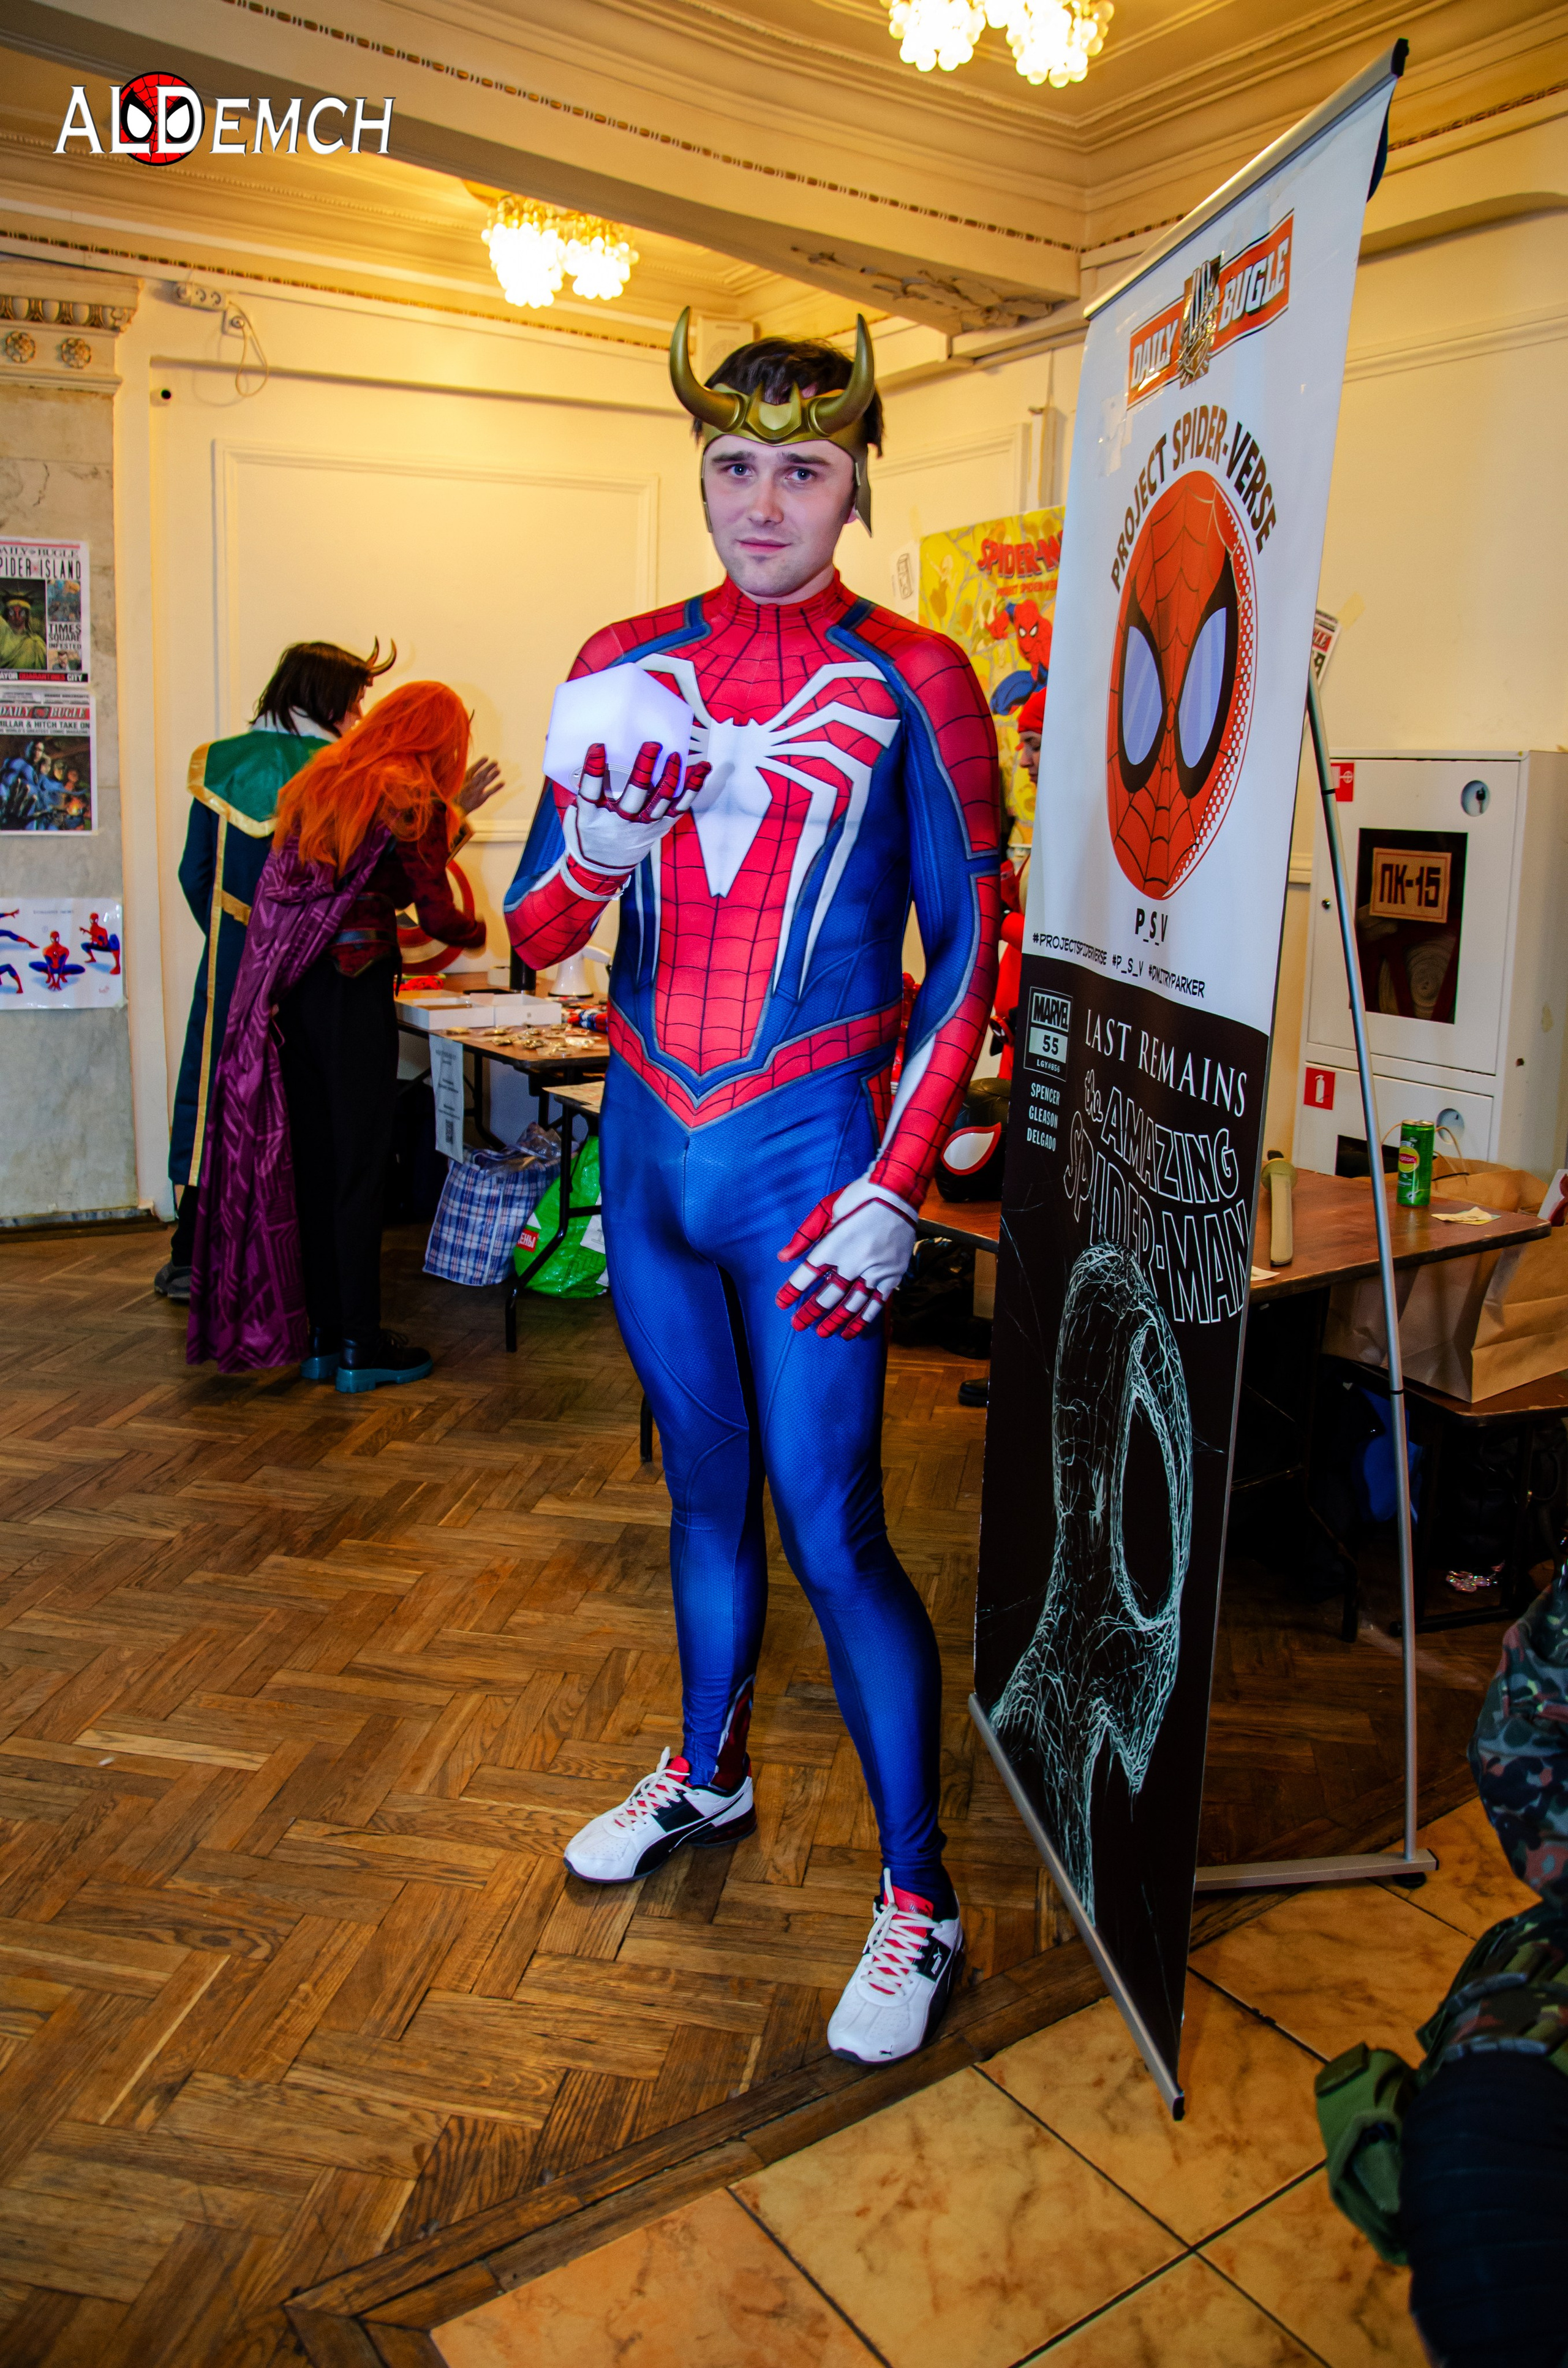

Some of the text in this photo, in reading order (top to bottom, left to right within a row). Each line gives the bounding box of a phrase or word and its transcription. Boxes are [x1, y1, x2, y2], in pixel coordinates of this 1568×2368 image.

[1130, 319, 1179, 389] DAILY
[1218, 236, 1290, 332] BUGLE
[1111, 404, 1277, 594] PROJECT SPIDER-VERSE
[977, 531, 1063, 578] SPIDER-M
[0, 557, 81, 580] PIDER ISLAND
[48, 632, 80, 643] SQUARE
[49, 624, 81, 634] TIMES
[0, 671, 18, 680] AYOR
[0, 706, 86, 718] DAILY BUGLE
[1379, 863, 1441, 908] ПК-15
[1033, 932, 1107, 965] #PROJECTSPIDERVERSE
[1148, 964, 1205, 998] #DMITRYPARKER
[1033, 995, 1069, 1030] MARVEL
[1042, 1034, 1060, 1056] 55
[1085, 1009, 1247, 1117] LAST REMAINS
[1031, 1083, 1060, 1105] SPENCER
[1028, 1105, 1058, 1129] GLEASON
[1027, 1127, 1057, 1152] DELGADO
[1101, 1086, 1239, 1205] AMAZING
[1063, 1111, 1251, 1324] SPIDER-MAN
[518, 1232, 537, 1249] ЕНЫ
